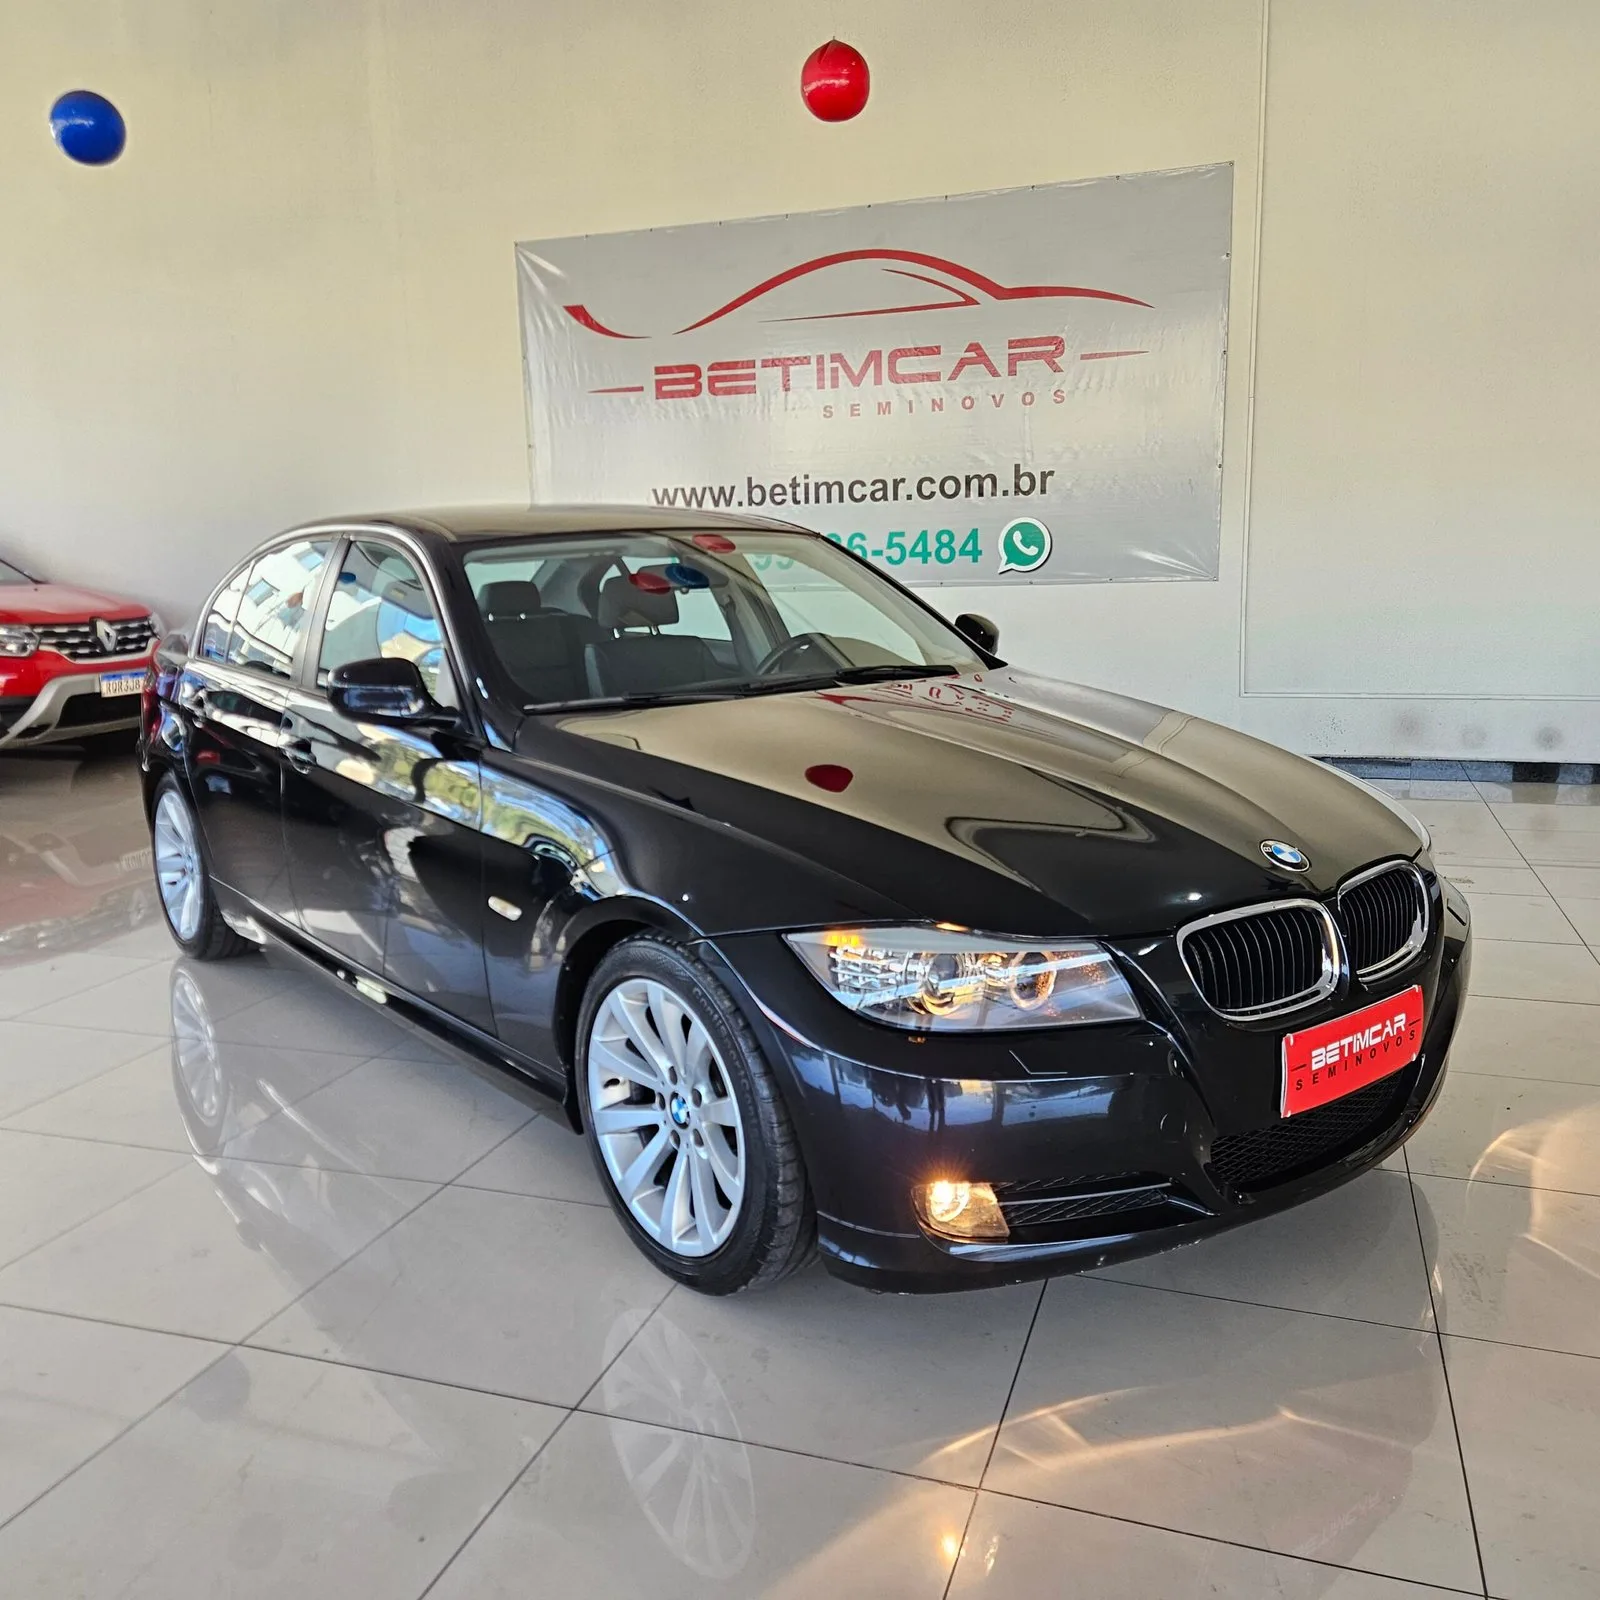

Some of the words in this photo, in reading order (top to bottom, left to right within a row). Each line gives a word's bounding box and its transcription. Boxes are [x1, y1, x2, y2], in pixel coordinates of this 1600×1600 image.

[654, 335, 1066, 400] BETIMCAR
[822, 388, 1066, 419] SEMINOVOS
[652, 464, 1056, 508] www.betimcar.com.br
[1295, 1029, 1415, 1091] SEMINOVOS
[1311, 1013, 1406, 1071] BETIMCAR
